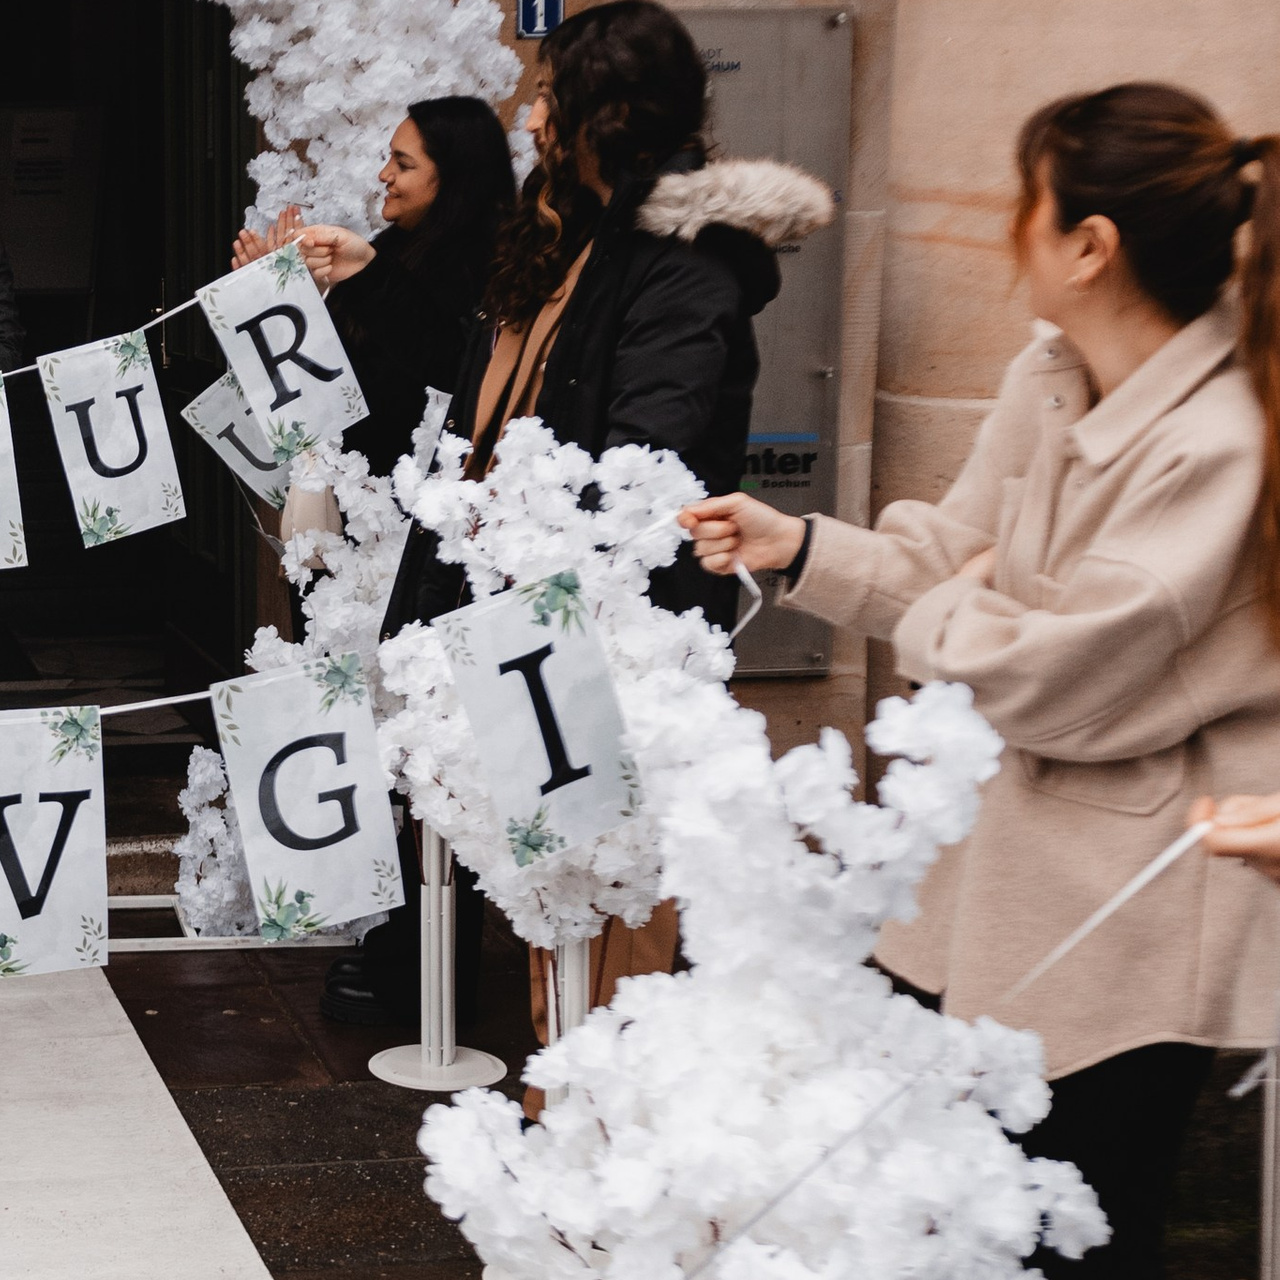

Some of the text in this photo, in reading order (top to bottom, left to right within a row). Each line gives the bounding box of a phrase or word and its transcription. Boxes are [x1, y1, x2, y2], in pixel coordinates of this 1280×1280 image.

[698, 48, 723, 60] ADT
[704, 60, 741, 73] CHUM
[739, 447, 818, 475] nter
[761, 479, 811, 489] Bochum
